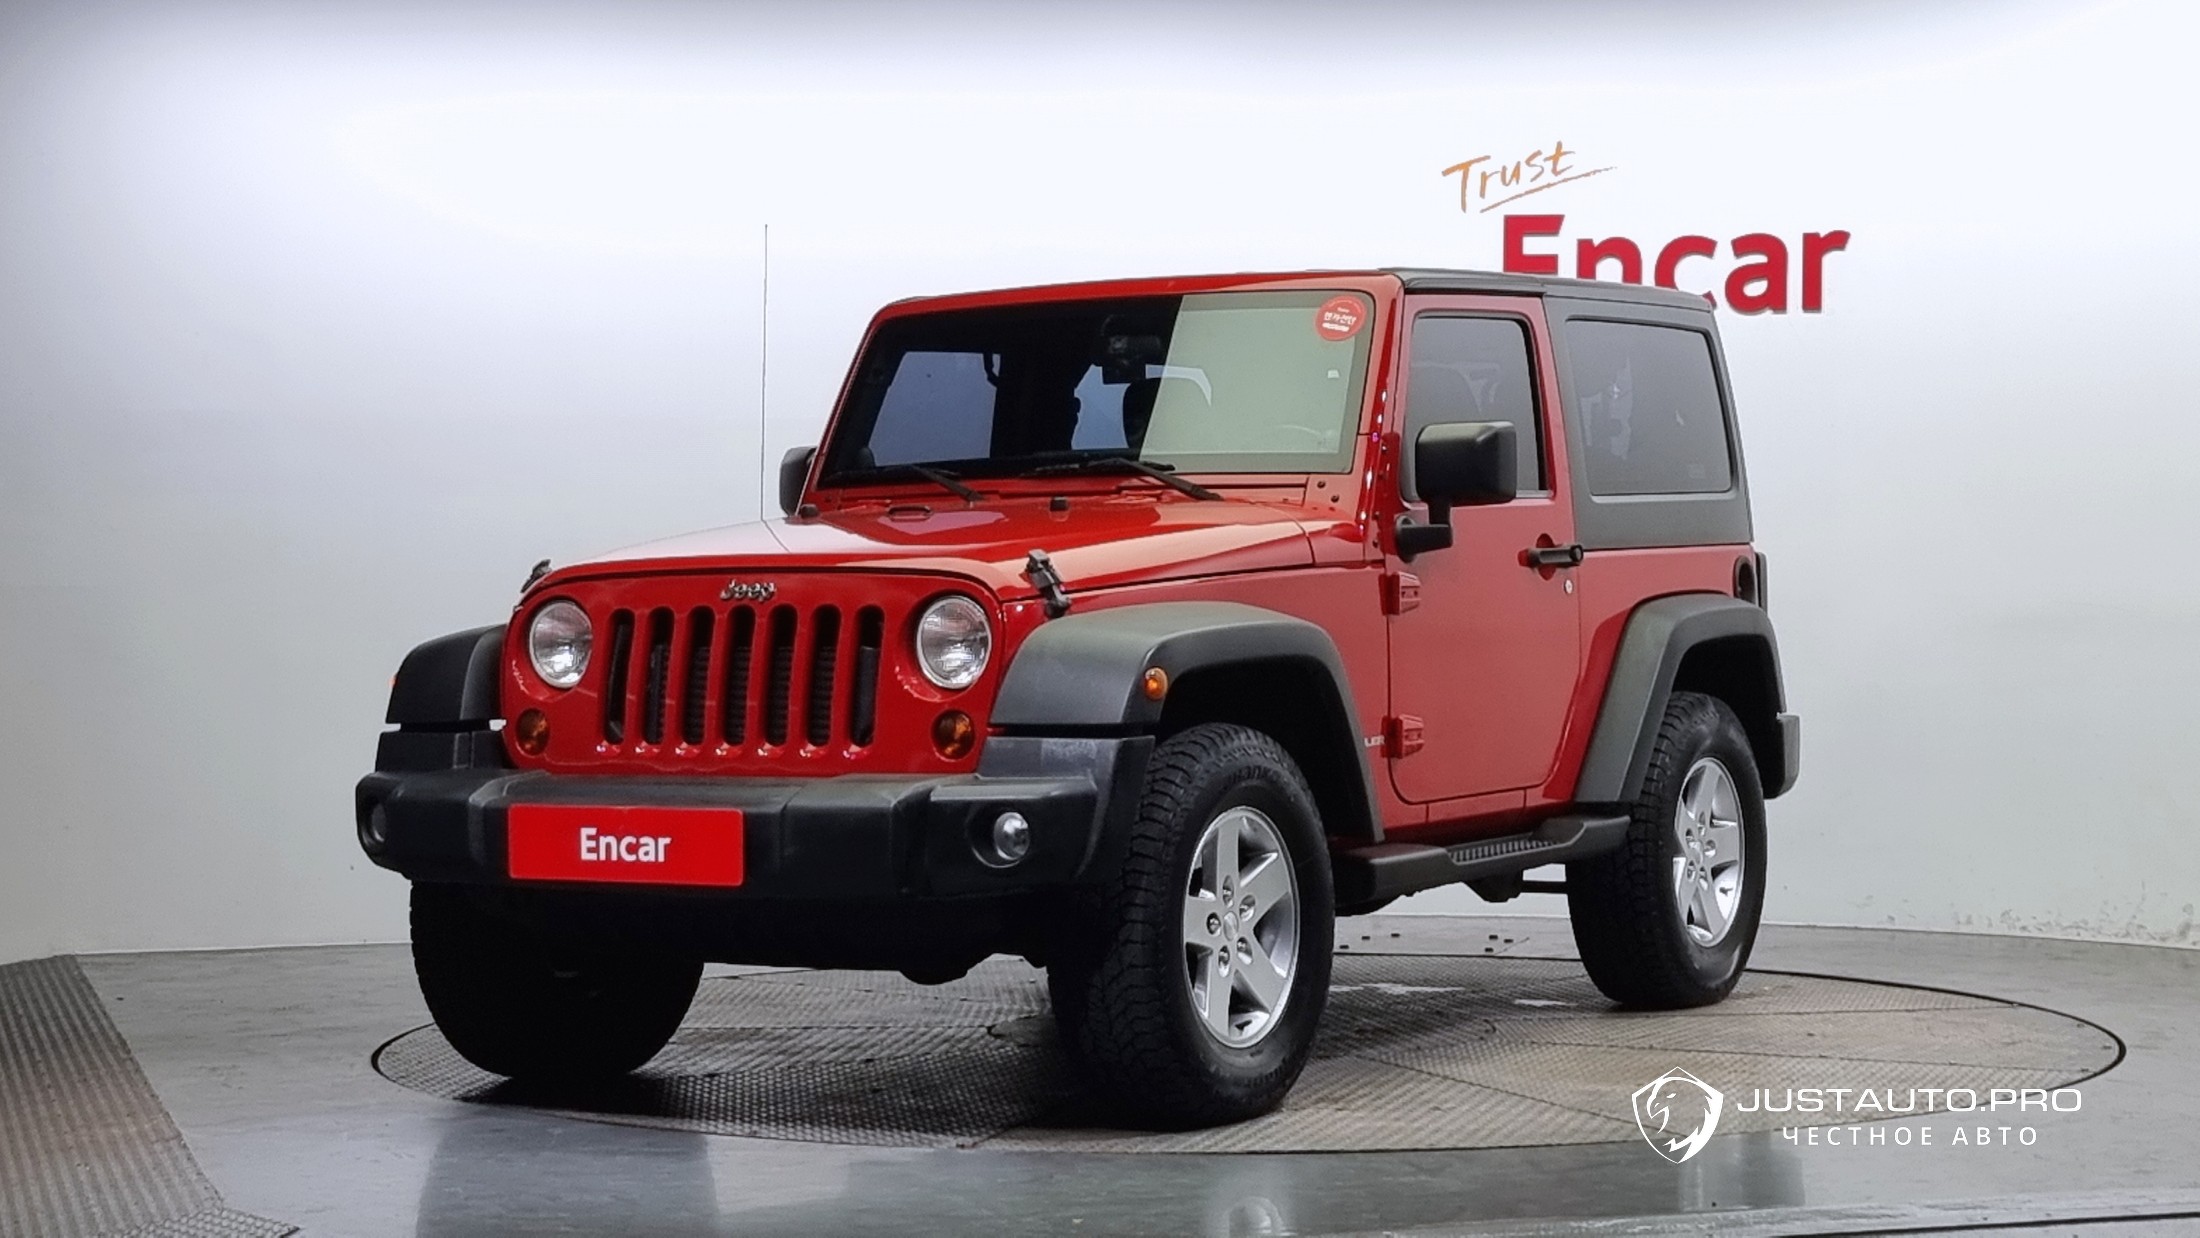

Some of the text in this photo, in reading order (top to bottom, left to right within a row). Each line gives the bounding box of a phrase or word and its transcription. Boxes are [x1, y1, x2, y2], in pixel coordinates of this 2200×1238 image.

[1442, 141, 1576, 213] Trust
[1503, 214, 1851, 315] Encar
[720, 579, 776, 601] Jeep
[580, 827, 672, 862] Encar
